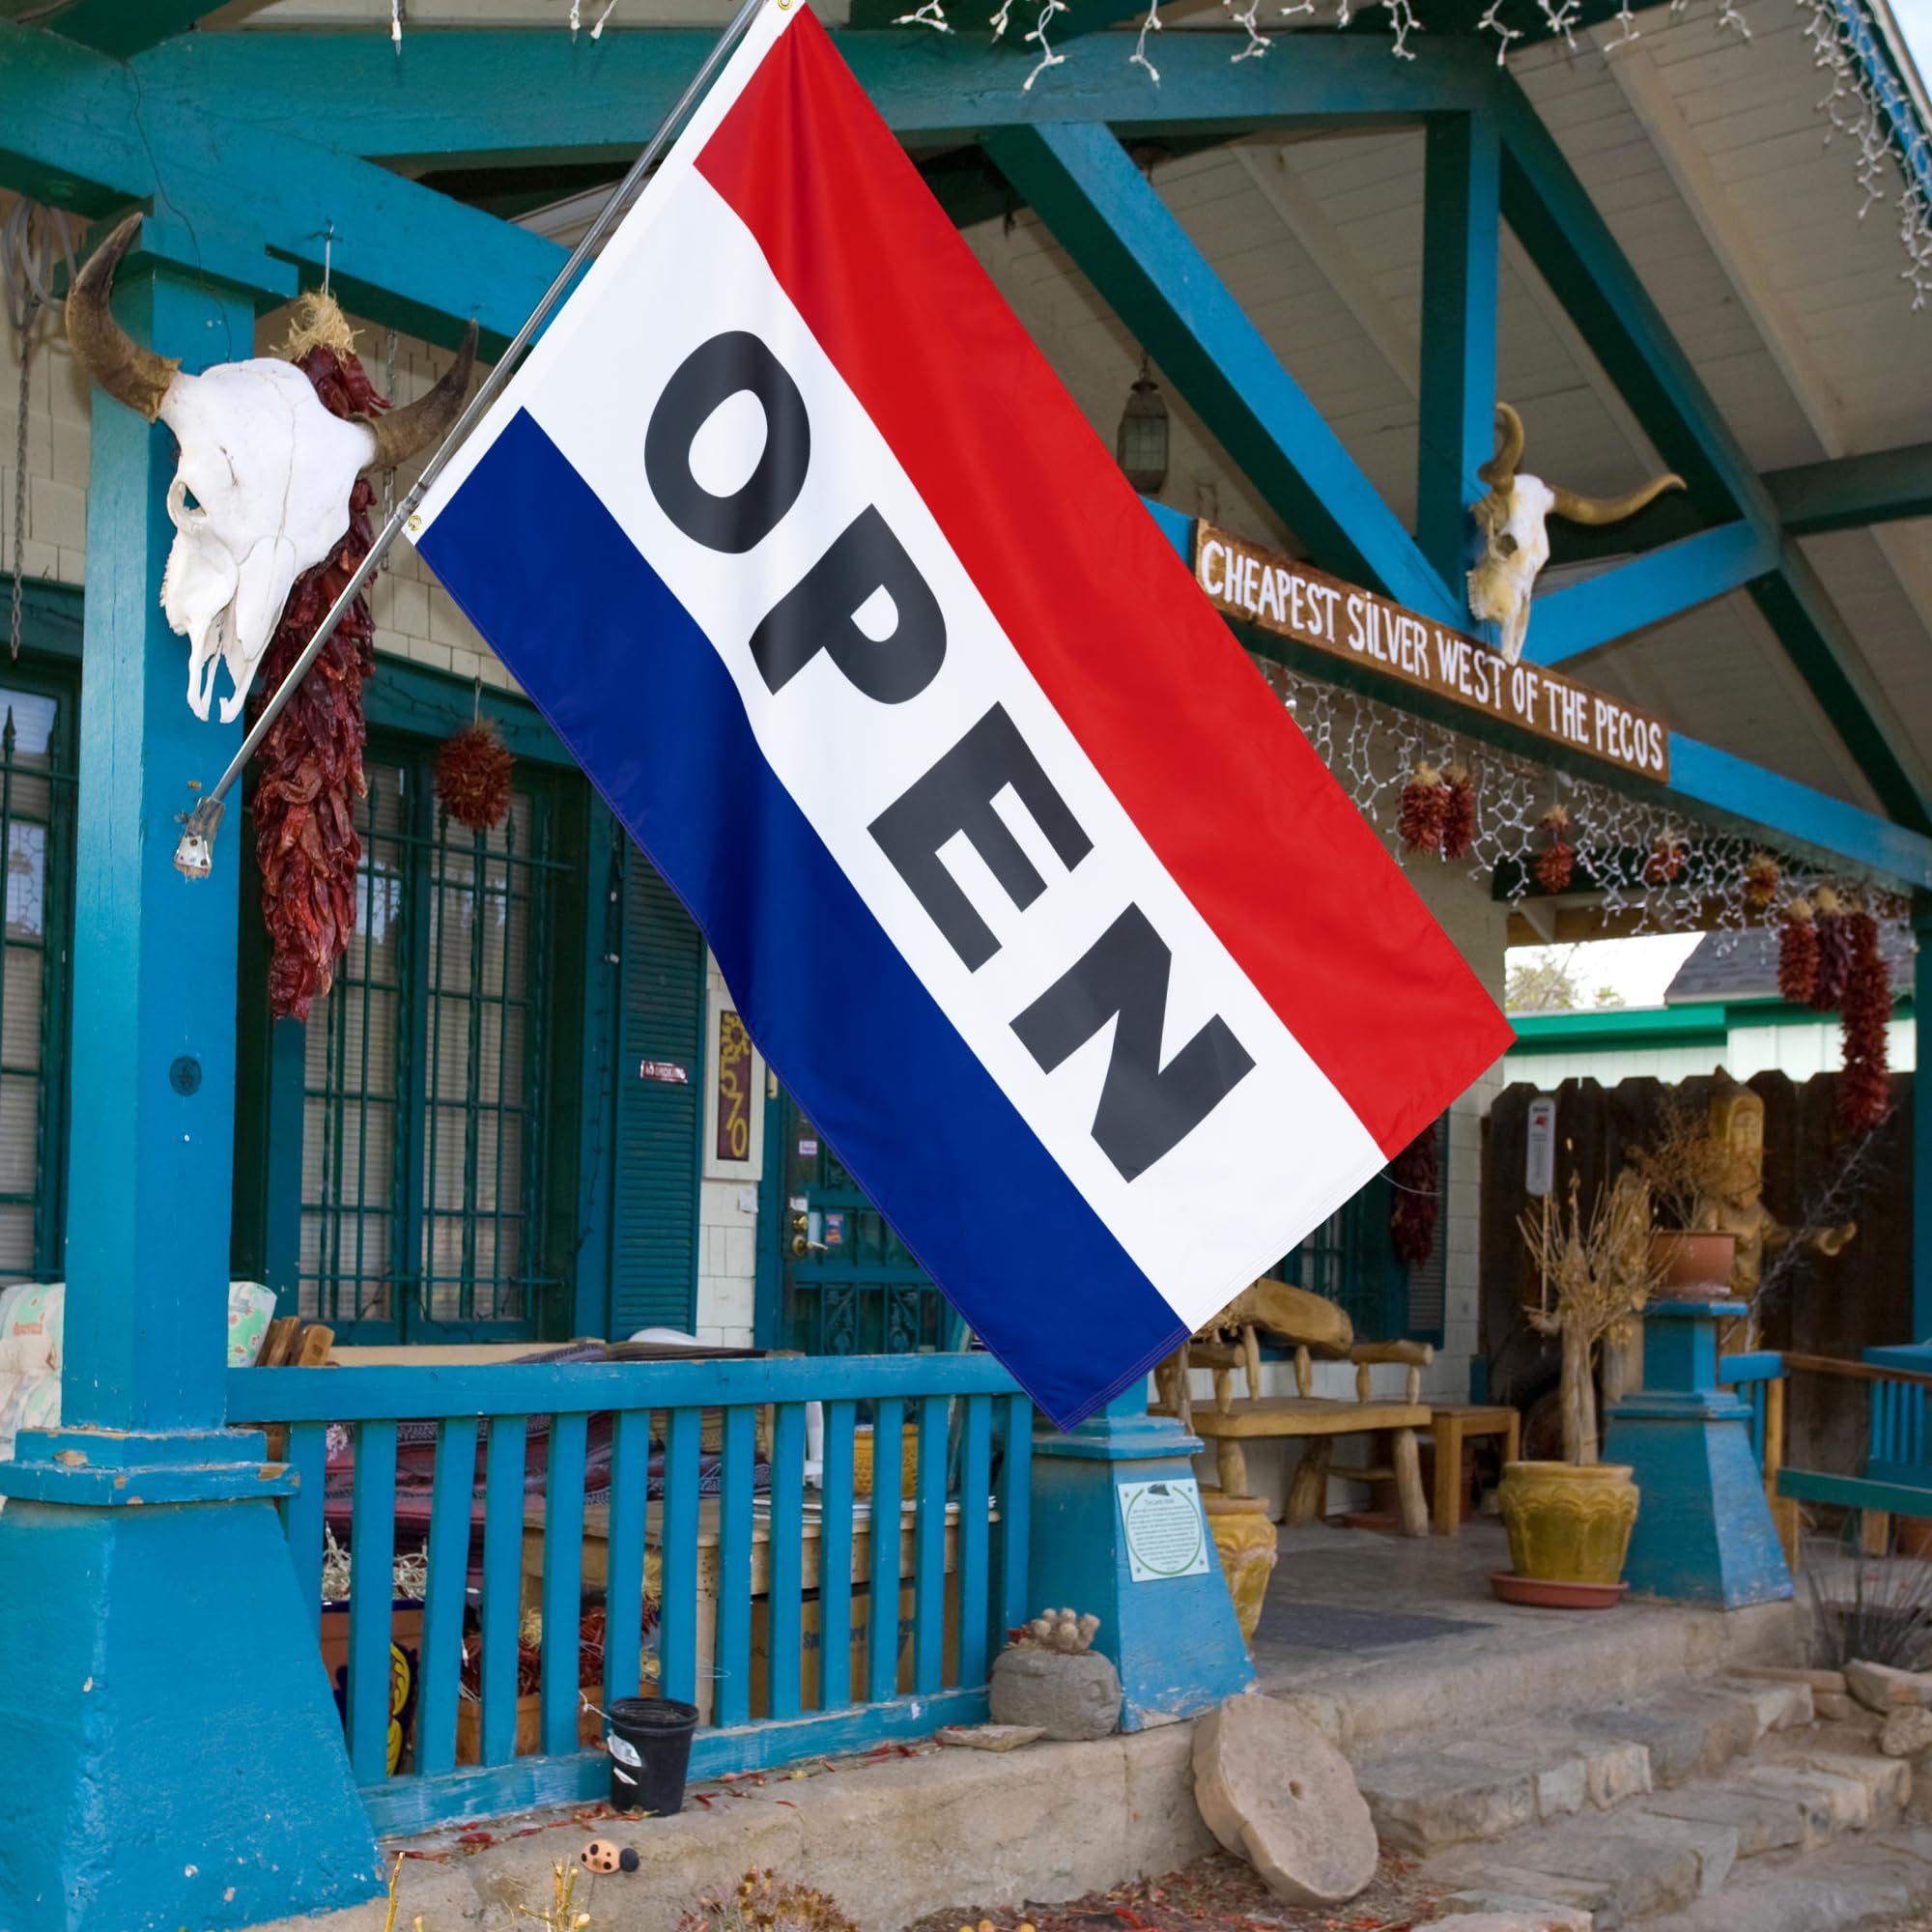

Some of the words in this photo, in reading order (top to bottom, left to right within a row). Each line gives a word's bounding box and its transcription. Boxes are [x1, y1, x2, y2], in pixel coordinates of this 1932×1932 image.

[644, 330, 1257, 1183] OPEN
[1201, 540, 1341, 643] CHEAPEST
[1435, 629, 1506, 710] WEST
[1511, 667, 1538, 724] OF
[1543, 679, 1589, 744] THE
[1594, 698, 1663, 770] PECOS
